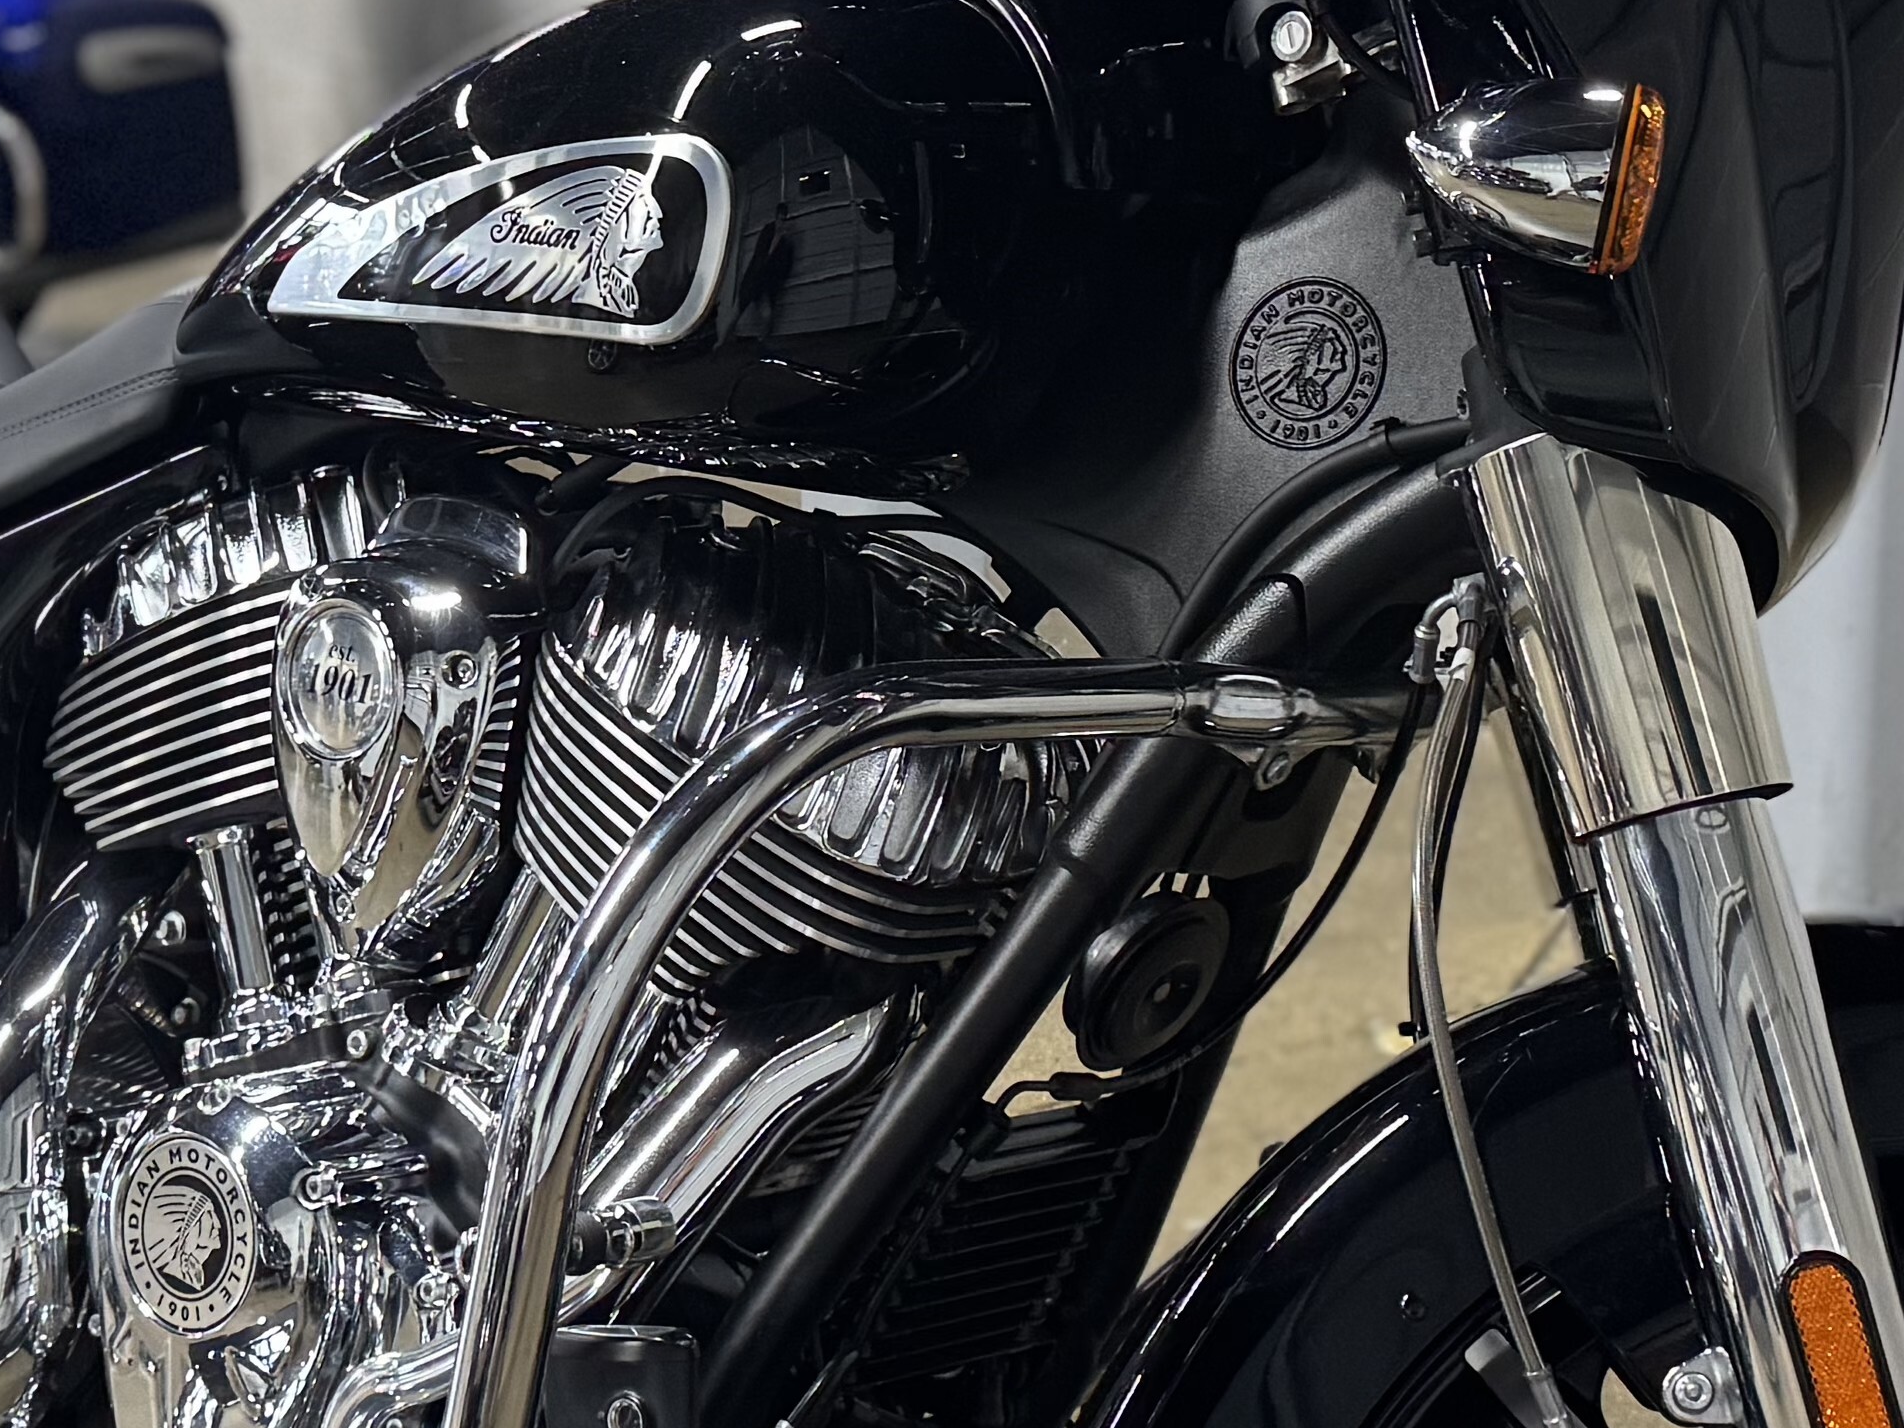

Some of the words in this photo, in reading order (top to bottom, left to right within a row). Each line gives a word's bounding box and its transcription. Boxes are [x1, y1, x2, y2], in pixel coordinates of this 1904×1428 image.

[490, 210, 582, 251] Indian
[1239, 304, 1281, 405] INDIAN
[1286, 288, 1379, 419] MOTORCYCLE
[328, 641, 356, 664] est.
[309, 662, 373, 705] 1901
[129, 1159, 161, 1270] INDIAN
[169, 1146, 248, 1304] MOTORCYCLE
[156, 1293, 200, 1322] 1901
